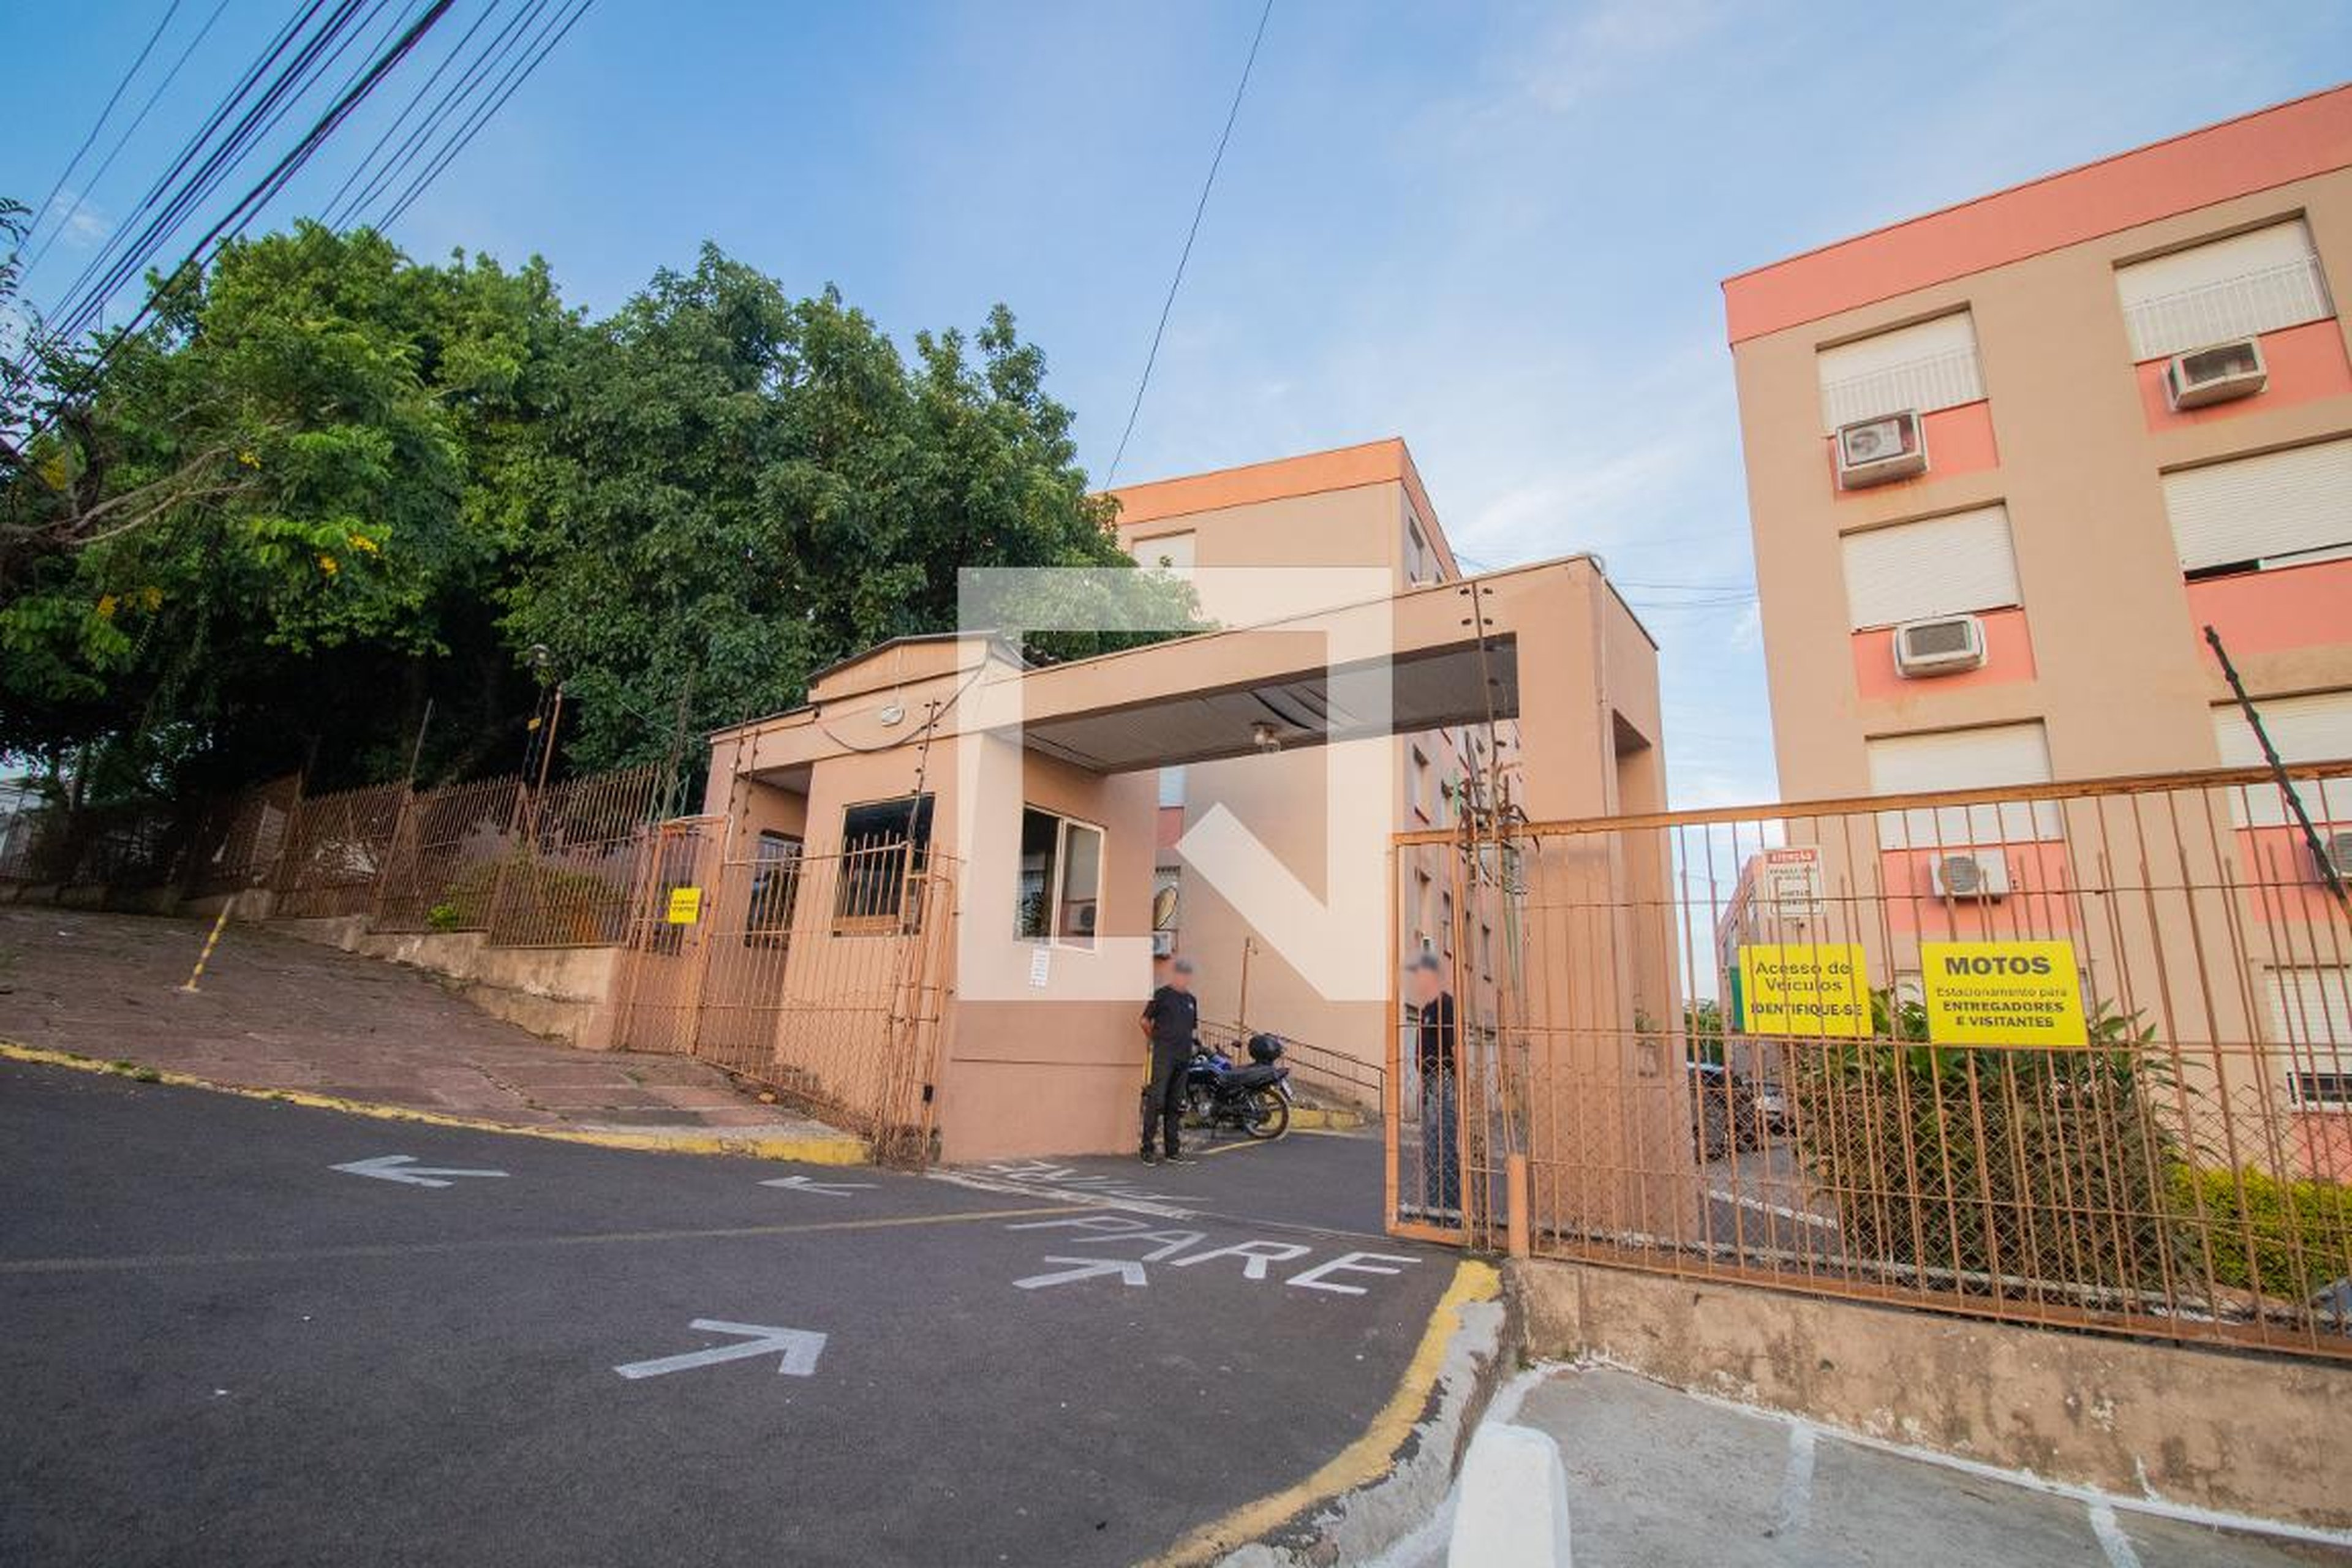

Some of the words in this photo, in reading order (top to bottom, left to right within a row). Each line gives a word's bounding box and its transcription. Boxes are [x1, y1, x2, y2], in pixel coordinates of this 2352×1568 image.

[1755, 962, 1822, 974] Acesso
[1828, 962, 1852, 974] de
[1945, 956, 2051, 975] MOTOS
[1766, 977, 1842, 991] Veícuos
[1936, 987, 2036, 998] Estacionamento
[2039, 988, 2067, 1000] para
[1943, 1001, 2065, 1013] ENTREGADORES
[1956, 1016, 1964, 1026] E
[1969, 1016, 2054, 1027] VISITANTES
[1006, 1216, 1423, 1295] PARE
